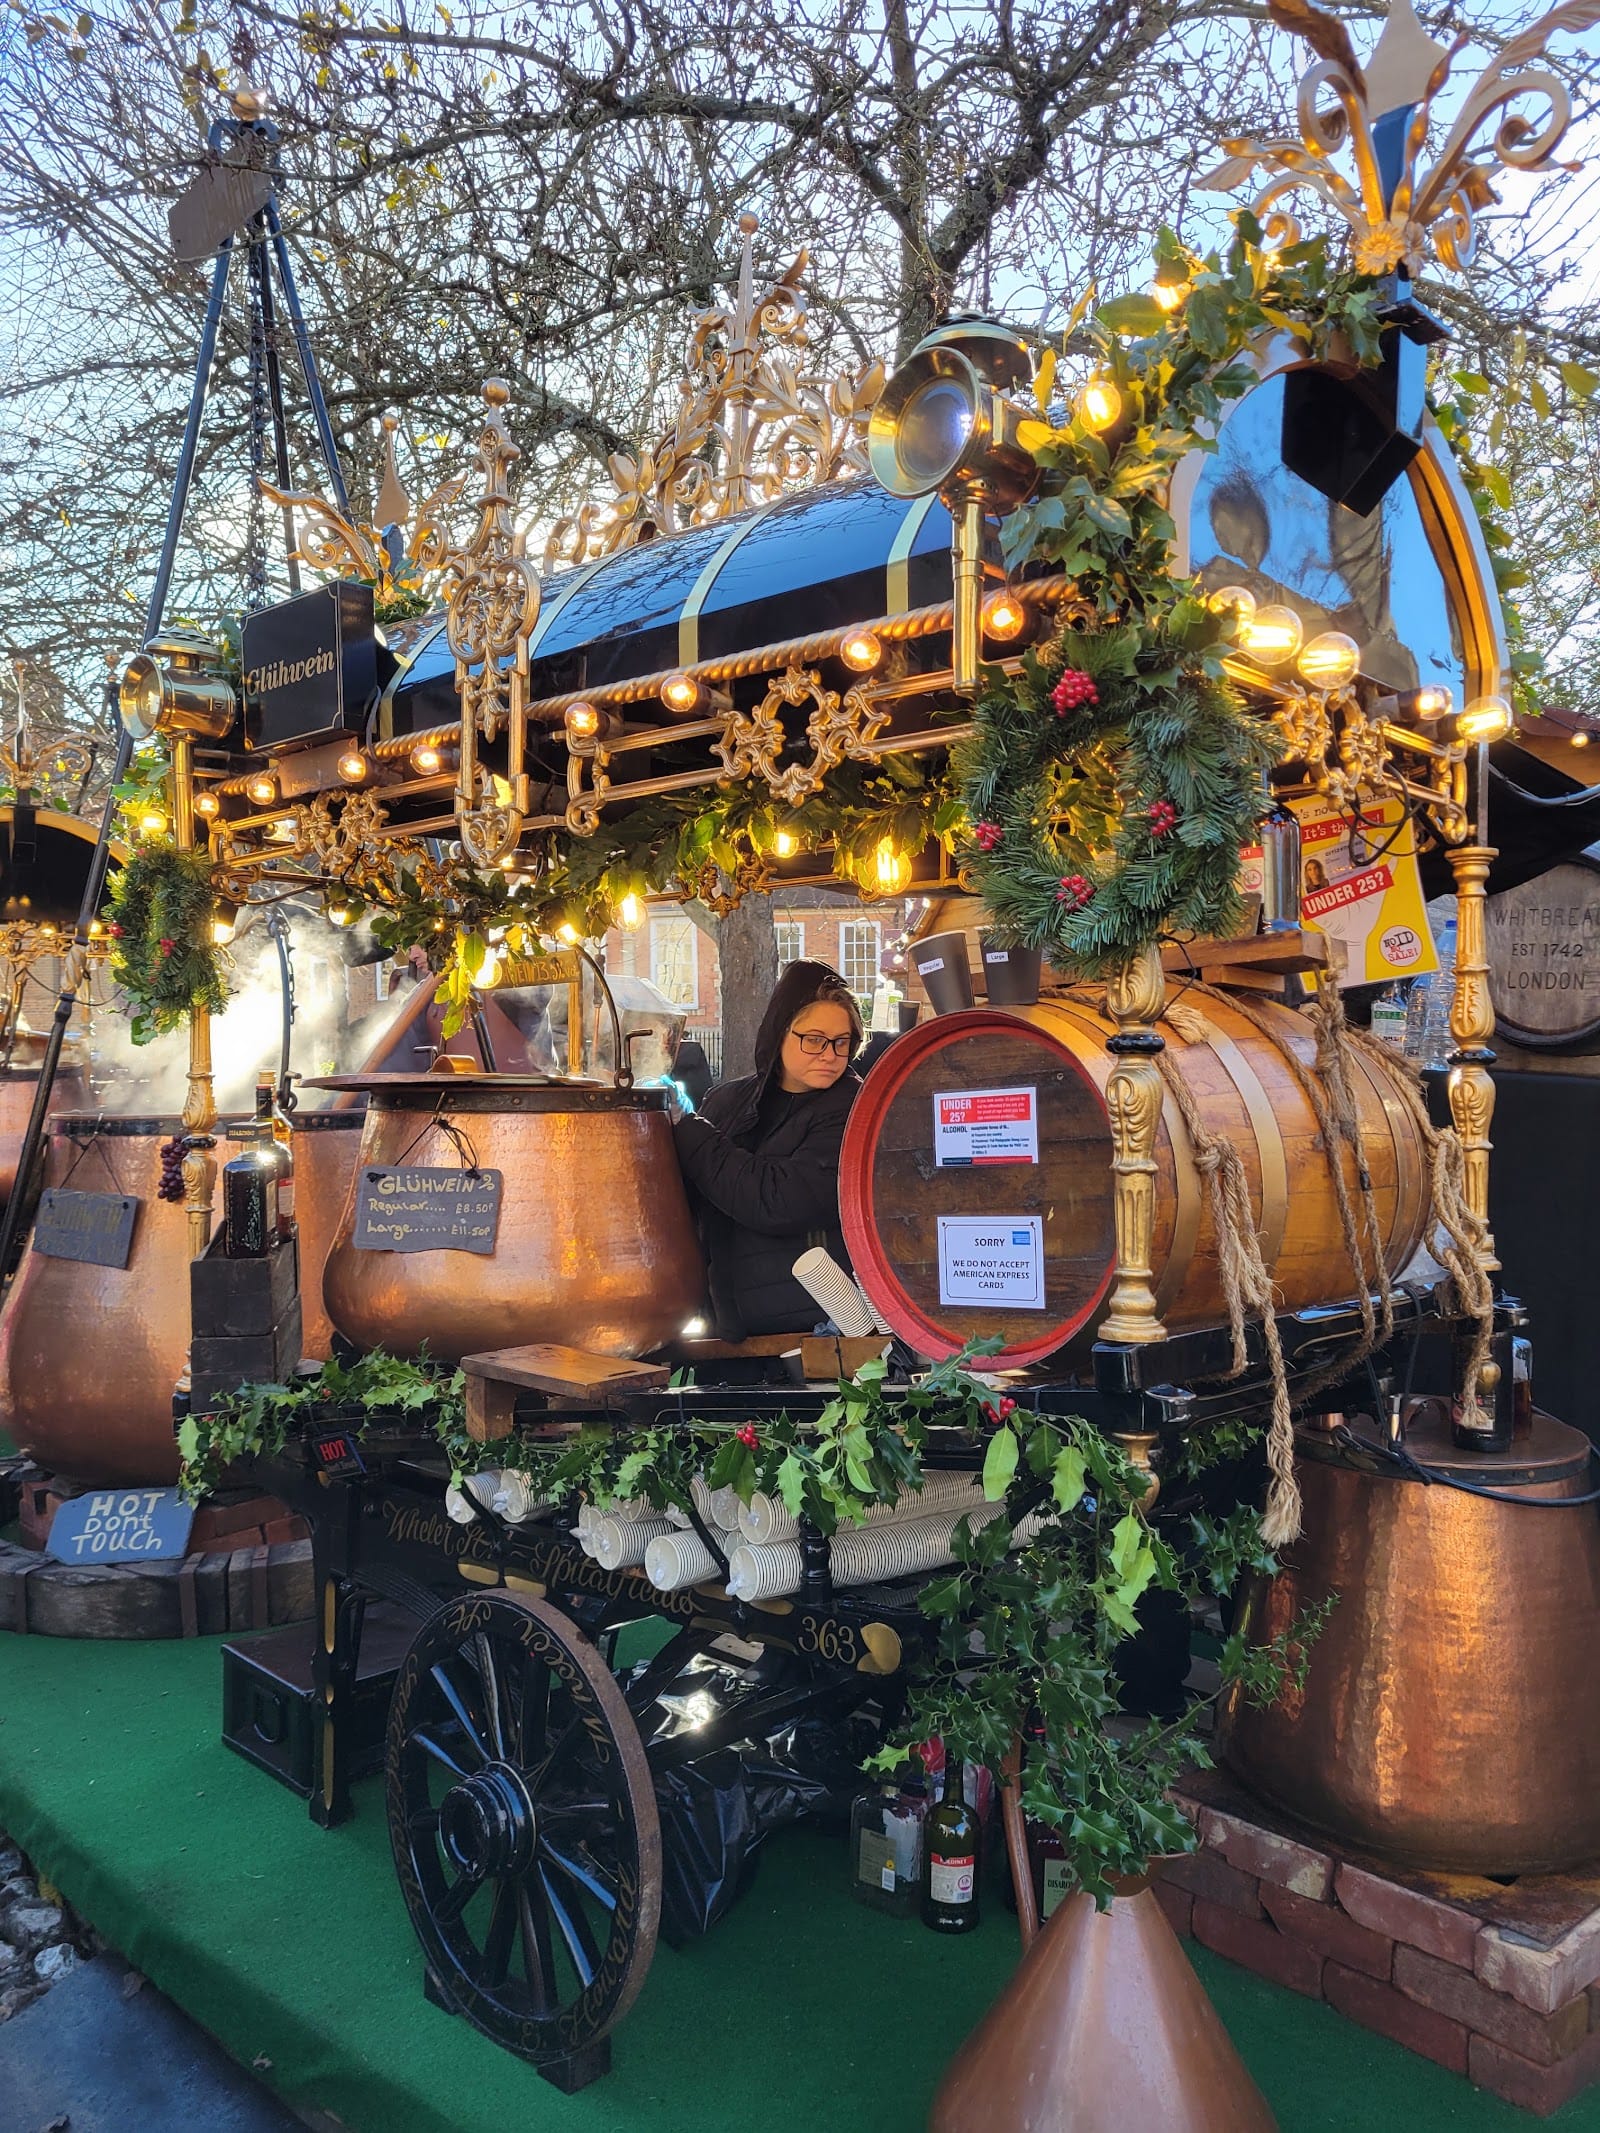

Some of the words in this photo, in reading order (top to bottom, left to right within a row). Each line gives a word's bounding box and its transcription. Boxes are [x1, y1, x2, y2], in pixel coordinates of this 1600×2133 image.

[246, 647, 334, 696] Glühwein
[1304, 824, 1327, 840] It's
[1331, 822, 1348, 834] th
[1305, 884, 1355, 914] UNDER
[1356, 871, 1385, 894] 25?
[1393, 930, 1414, 947] ID
[1387, 947, 1419, 962] SALE!
[1511, 943, 1535, 957] EST
[1543, 943, 1584, 957] 1742
[1507, 971, 1585, 990] LONDON
[943, 1098, 972, 1110] UNDER
[949, 1111, 965, 1123] 25?
[942, 1126, 968, 1134] ALCOHOL
[377, 1173, 475, 1195] GLÜHWEIN
[974, 1238, 1006, 1247] SORRY
[980, 1260, 997, 1268] NOT
[953, 1270, 995, 1278] AMERICAN
[996, 1271, 1030, 1279] EXPRESS
[978, 1281, 1005, 1289] CARDS
[319, 1439, 347, 1461] HOT
[89, 1492, 166, 1517] HOT
[798, 1615, 858, 1665] 363
